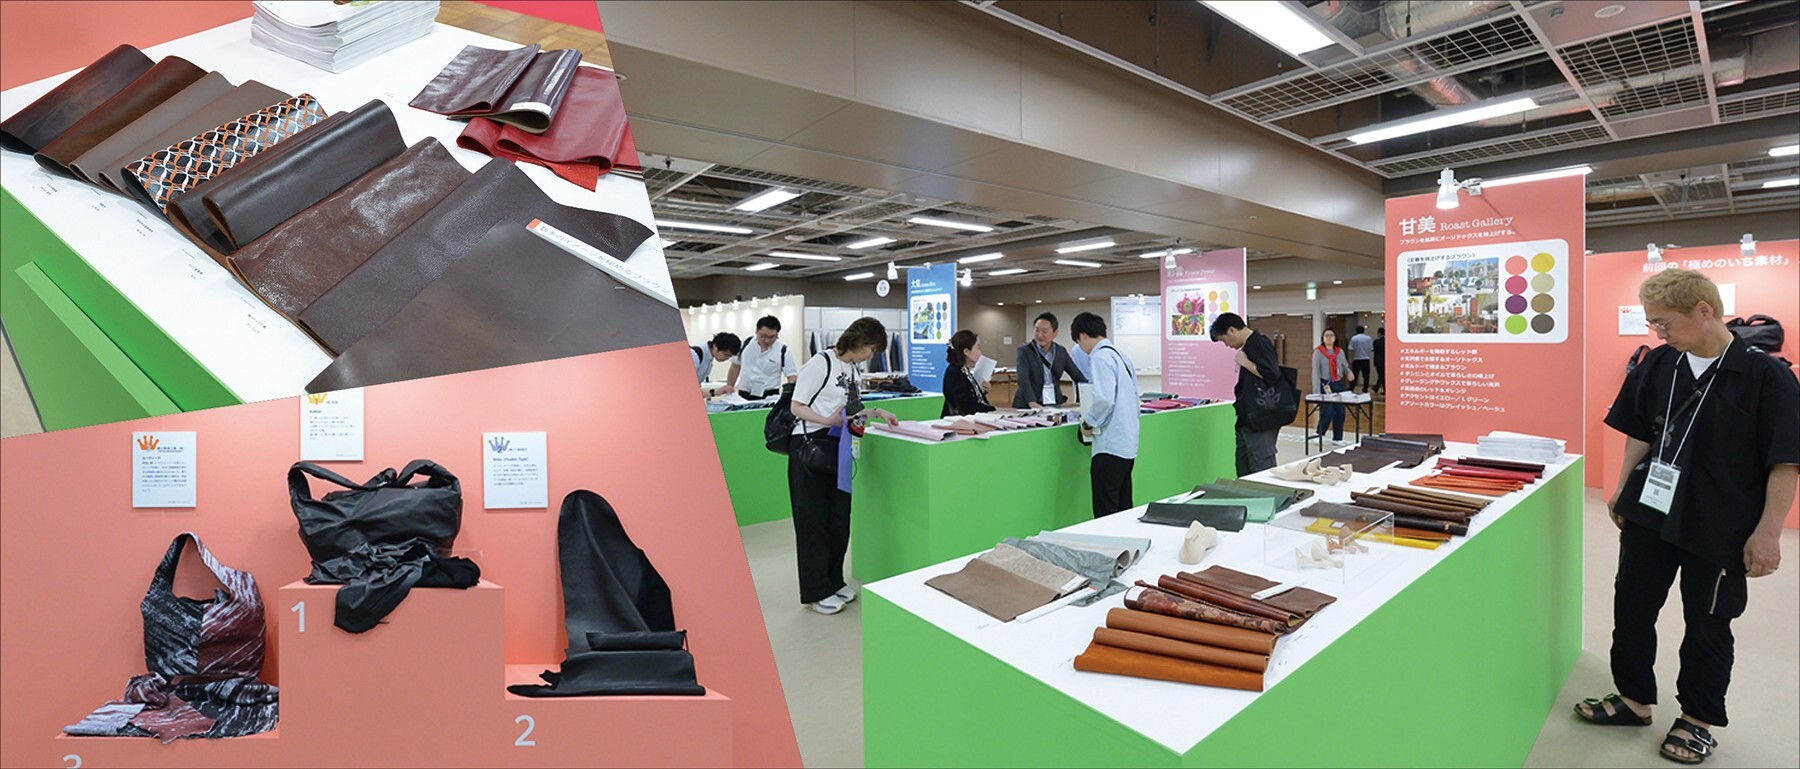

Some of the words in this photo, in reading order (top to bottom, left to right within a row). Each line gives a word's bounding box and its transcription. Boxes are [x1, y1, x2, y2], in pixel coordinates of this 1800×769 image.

[1399, 215, 1436, 236] 甘美
[1440, 220, 1470, 231] Roast
[1472, 216, 1513, 229] Gallery
[291, 601, 305, 633] 1
[514, 714, 536, 746] 2
